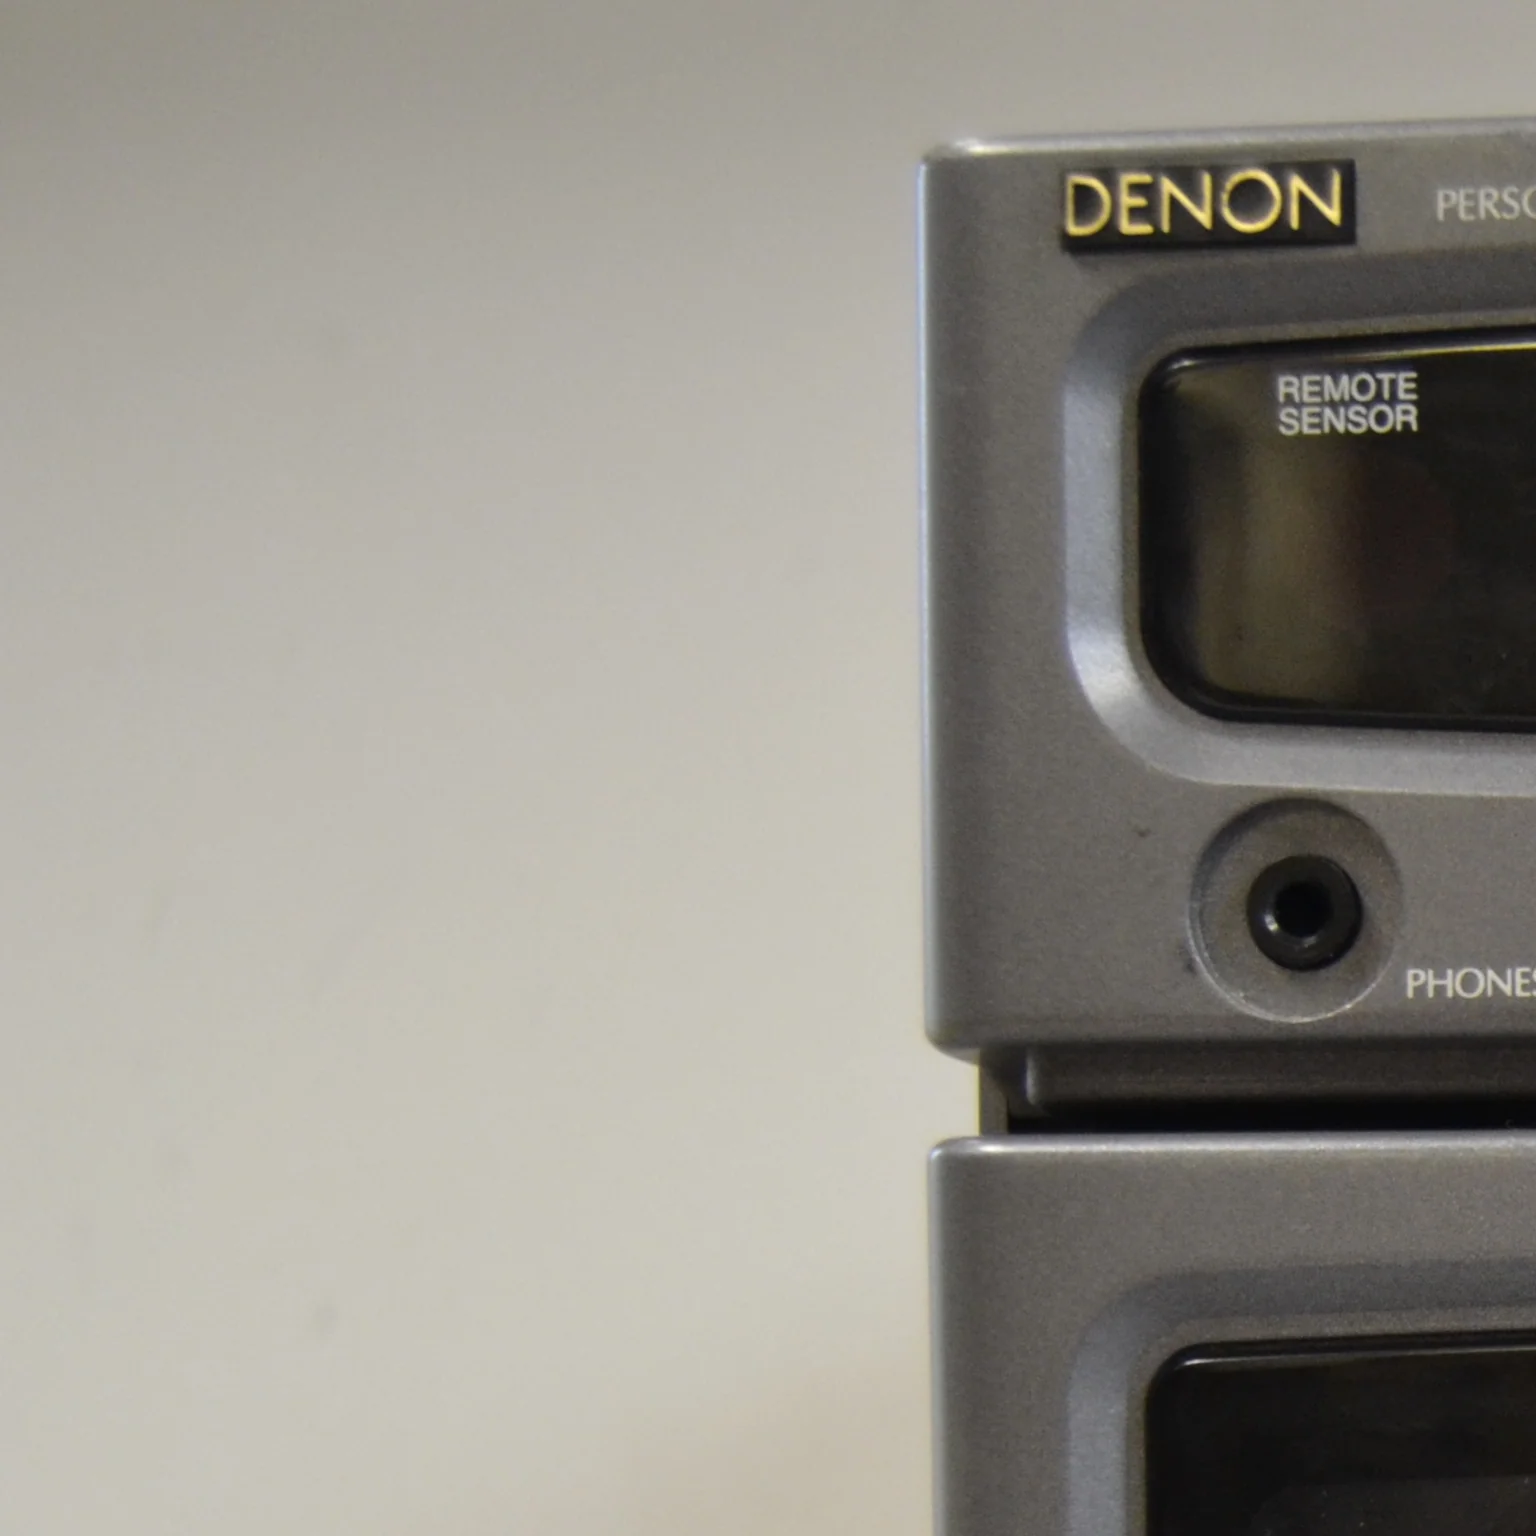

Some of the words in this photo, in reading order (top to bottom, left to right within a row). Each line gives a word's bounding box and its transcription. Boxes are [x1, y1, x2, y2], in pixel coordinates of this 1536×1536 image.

[1064, 168, 1343, 237] DENON
[1279, 371, 1418, 404] REMOTE
[1279, 402, 1418, 436] SENSOR
